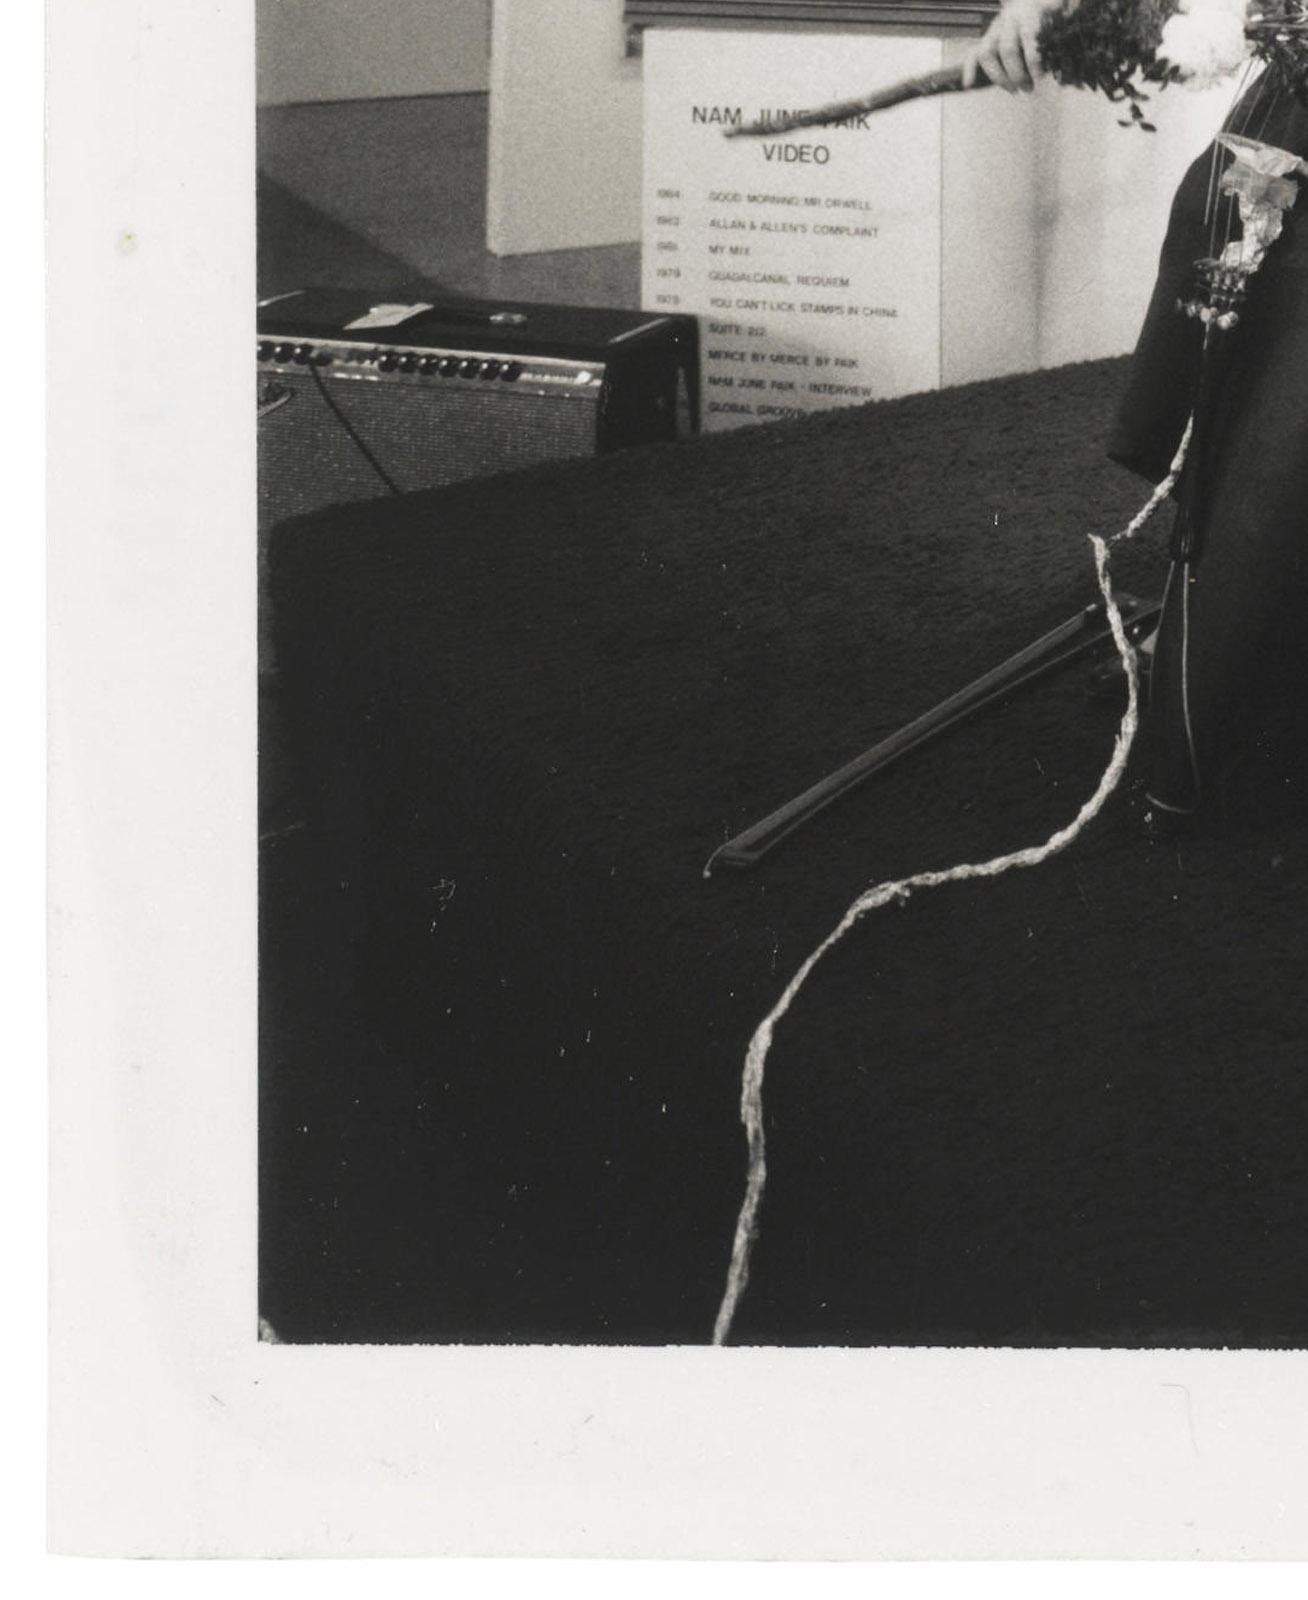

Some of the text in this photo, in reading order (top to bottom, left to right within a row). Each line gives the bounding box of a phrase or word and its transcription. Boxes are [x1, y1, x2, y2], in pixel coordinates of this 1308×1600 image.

[692, 105, 743, 127] NAM
[763, 143, 831, 165] VIDEO
[813, 224, 879, 238] COMPLAINT
[797, 276, 850, 288] REQUIEM
[769, 302, 796, 313] LICK
[800, 302, 845, 316] STAMPS
[809, 383, 873, 398] INTERVIEW
